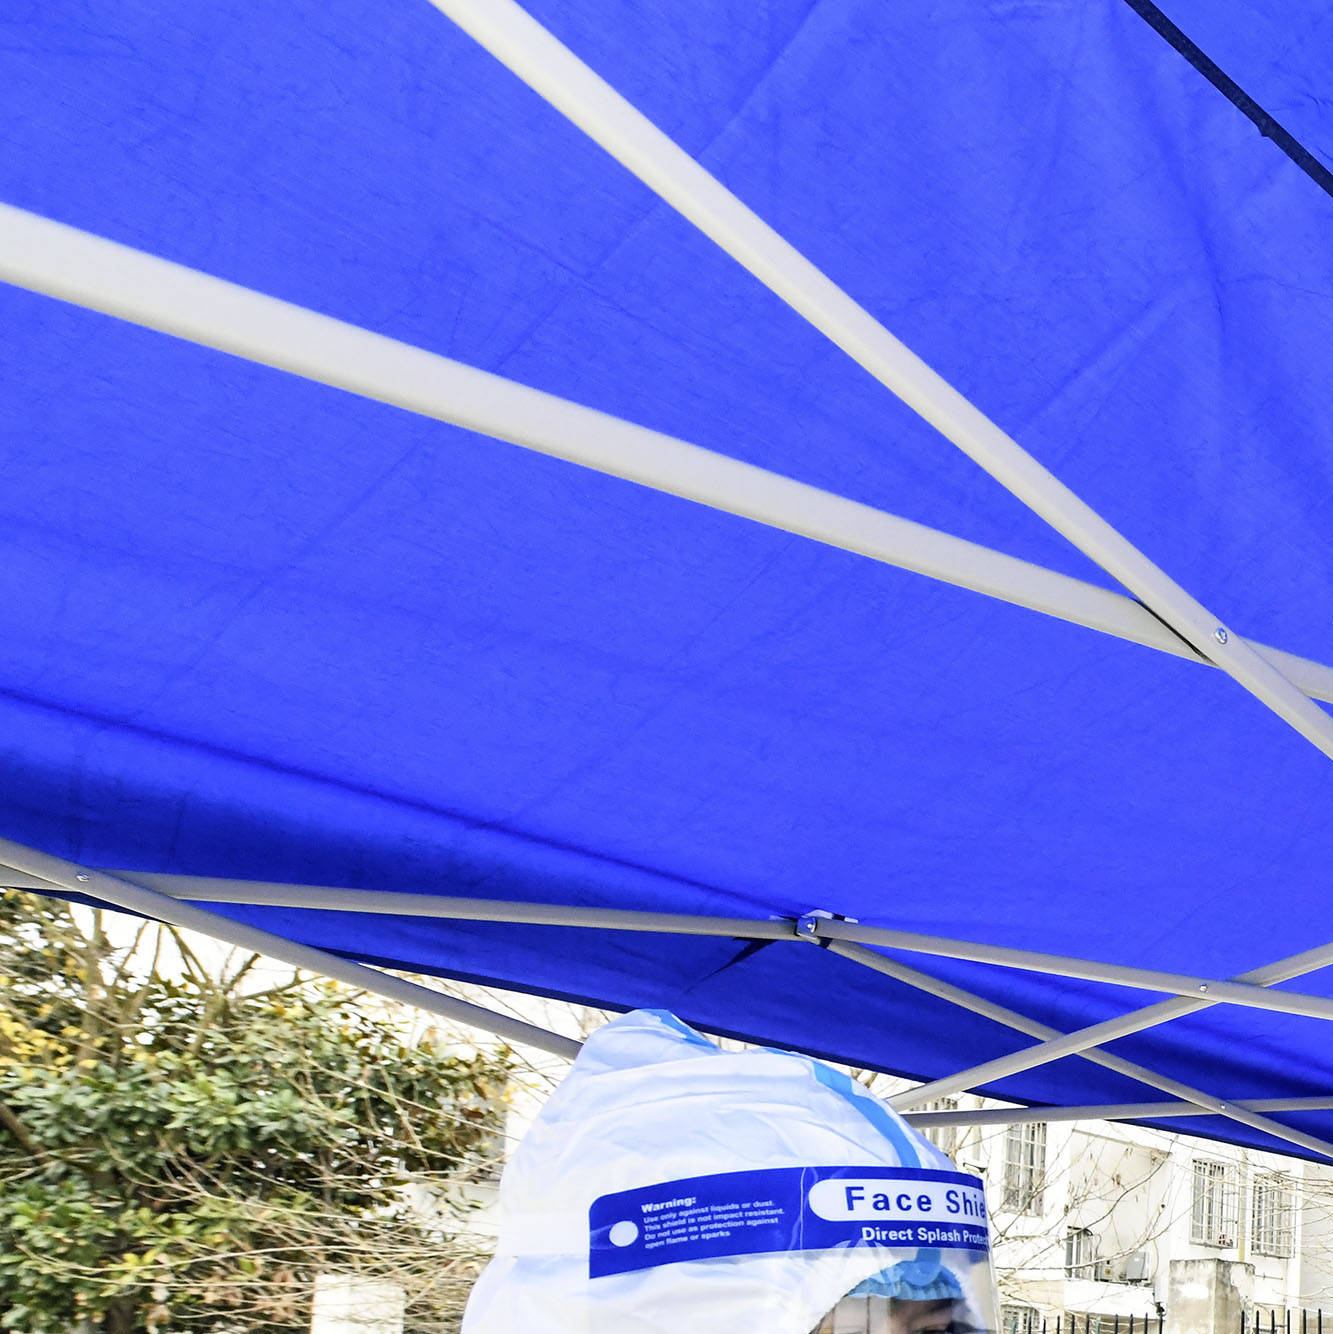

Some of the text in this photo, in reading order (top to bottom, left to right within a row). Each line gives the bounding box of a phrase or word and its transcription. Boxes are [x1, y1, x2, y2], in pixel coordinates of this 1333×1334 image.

[641, 1197, 696, 1213] Warning:
[845, 1186, 932, 1212] Face
[643, 1216, 659, 1224] Use
[660, 1212, 677, 1220] only
[679, 1207, 709, 1217] against
[710, 1203, 740, 1212] liquids
[644, 1224, 661, 1232] This
[662, 1218, 687, 1228] shield
[697, 1214, 712, 1222] not
[713, 1211, 743, 1220] impact
[644, 1233, 656, 1241] Do
[657, 1230, 670, 1238] not
[671, 1227, 687, 1235] use
[700, 1220, 745, 1231] protection
[746, 1217, 779, 1227] against
[645, 1240, 665, 1249] open
[666, 1236, 688, 1245] flame
[701, 1230, 731, 1240] sparks
[861, 1226, 914, 1241] Direct
[917, 1227, 961, 1243] Splash
